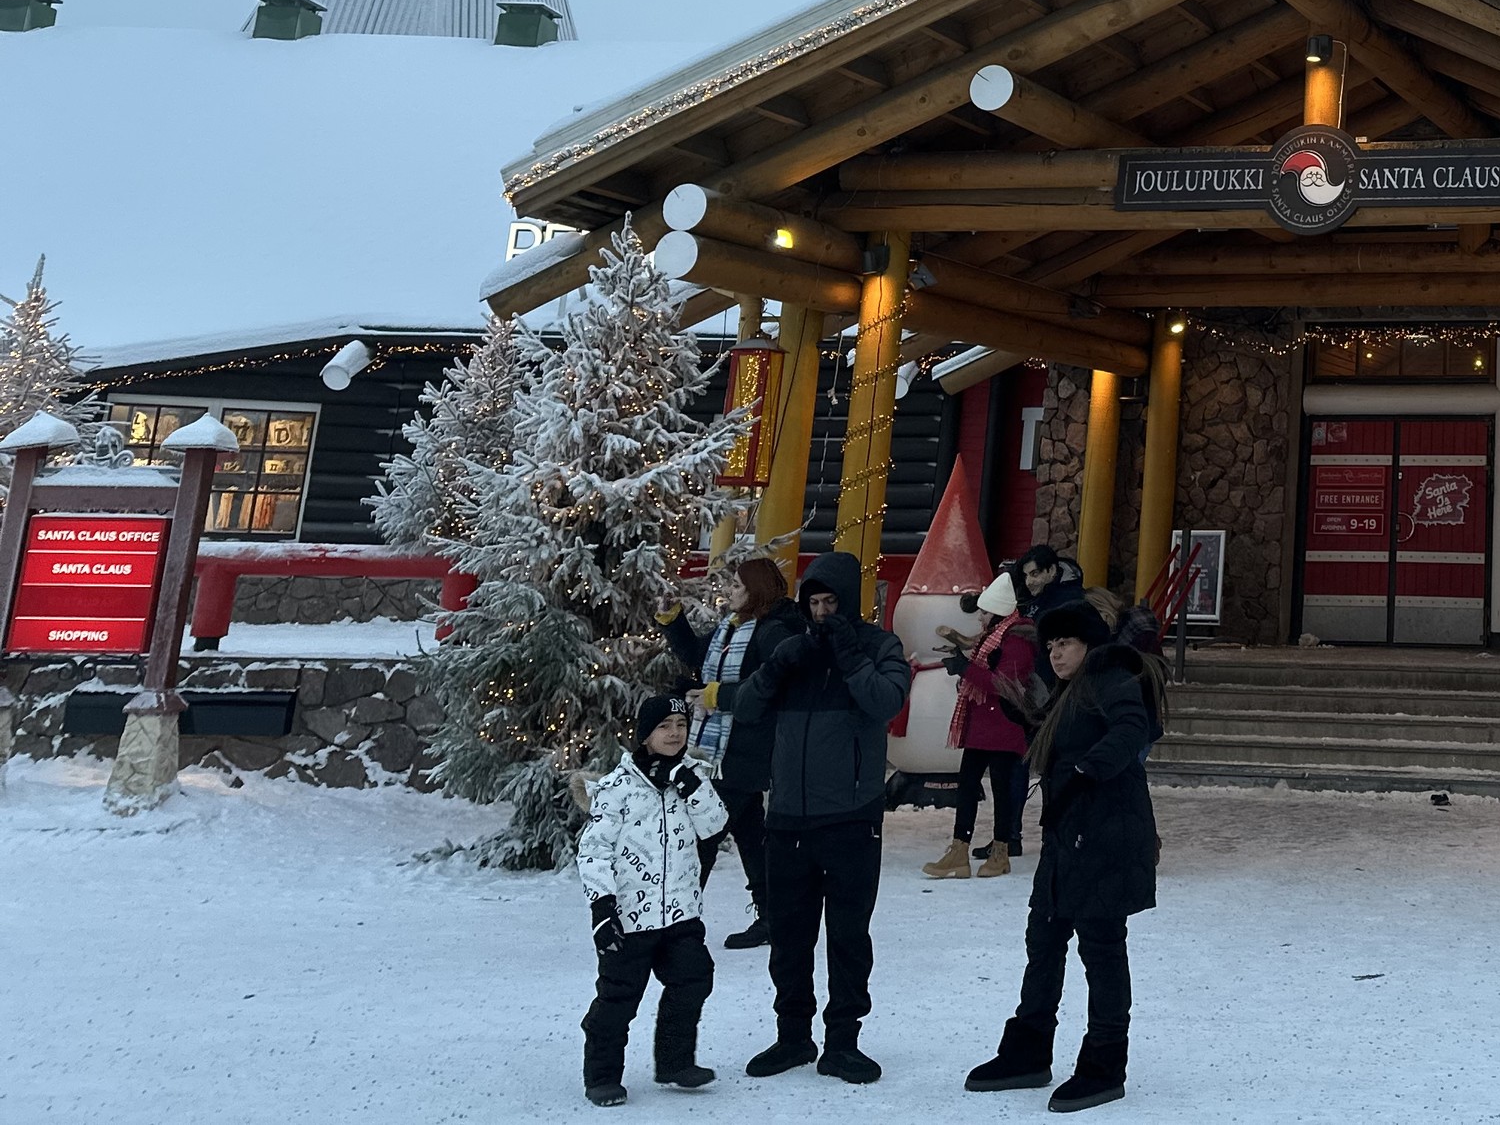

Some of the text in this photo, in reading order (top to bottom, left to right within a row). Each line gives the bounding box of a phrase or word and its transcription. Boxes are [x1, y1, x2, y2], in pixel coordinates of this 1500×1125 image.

[1133, 168, 1264, 196] JOULUPUKKI
[1358, 165, 1500, 190] SANTA CLAUS
[1293, 212, 1324, 224] CLAUS
[1425, 481, 1458, 500] Santa
[1320, 495, 1380, 505] FREE ENTRANCE
[1350, 518, 1377, 530] 9-19
[37, 530, 160, 543] SANTA CLAUS OFFICE
[51, 563, 133, 575] SANTA CLAUS
[48, 630, 109, 642] SHOPPING
[669, 698, 686, 713] N
